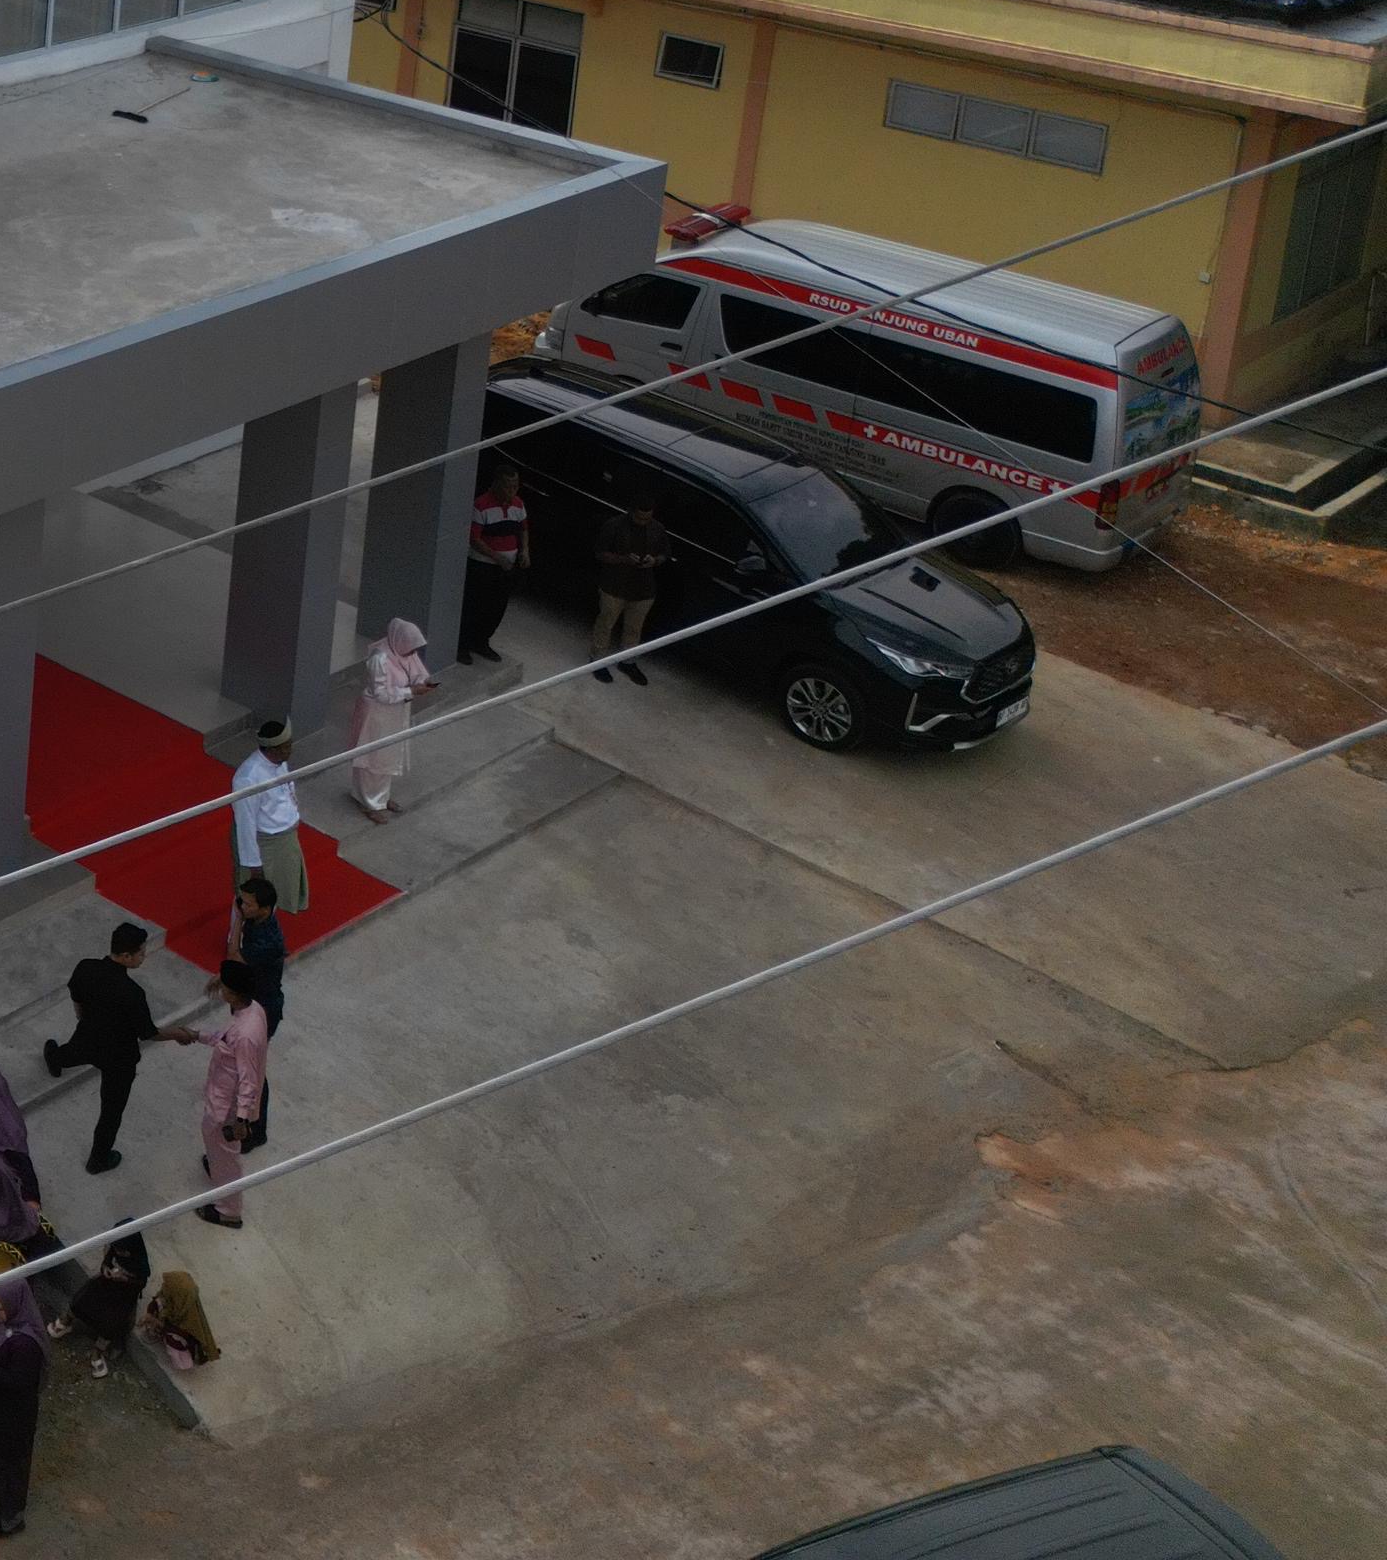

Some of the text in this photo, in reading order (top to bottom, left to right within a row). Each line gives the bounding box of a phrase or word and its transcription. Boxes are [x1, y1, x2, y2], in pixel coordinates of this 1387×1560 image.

[808, 293, 851, 313] RSUD
[932, 326, 979, 348] UBAN
[882, 431, 1044, 492] AMBULANCE
